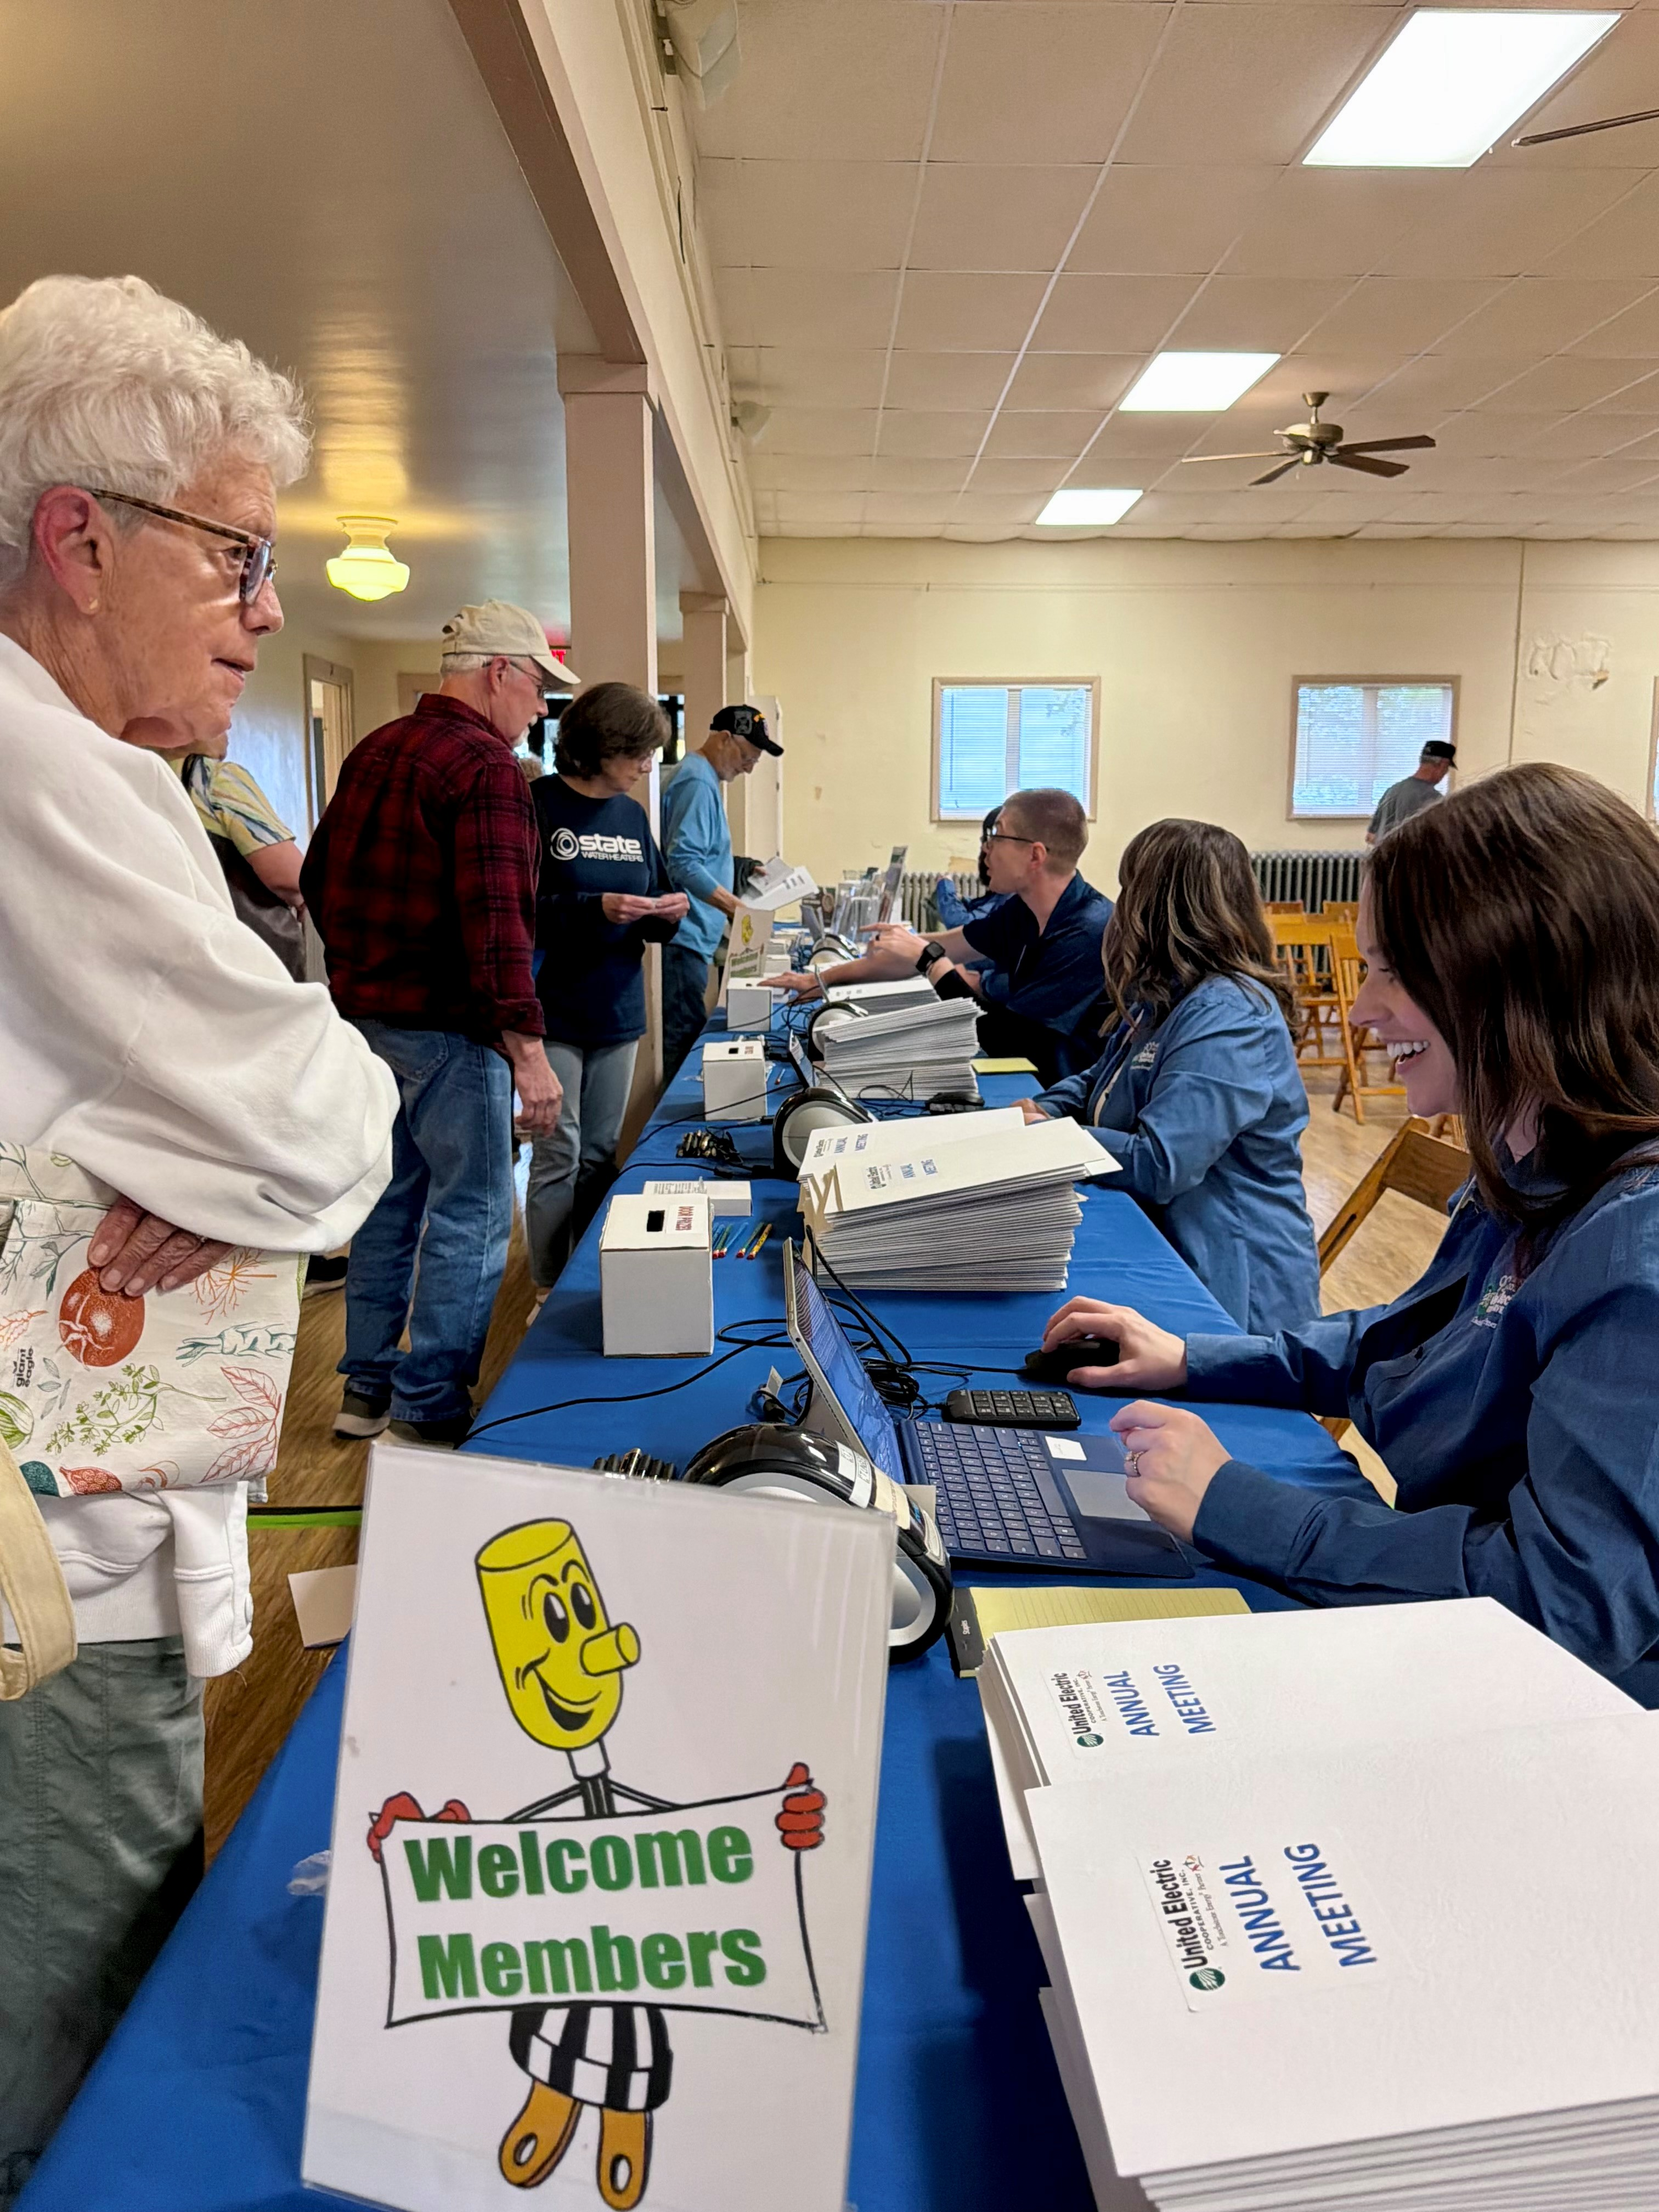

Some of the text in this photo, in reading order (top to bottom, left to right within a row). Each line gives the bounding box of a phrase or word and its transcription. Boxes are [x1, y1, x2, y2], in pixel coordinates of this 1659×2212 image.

[579, 833, 642, 855] state
[581, 851, 644, 862] WATER HEATERS
[16, 1349, 26, 1387] giant
[25, 1347, 35, 1387] eagle
[1051, 1672, 1092, 1735] United Electric
[1103, 1671, 1160, 1736] ANNUAL
[1153, 1664, 1217, 1734] MEETING
[403, 1825, 754, 1903] Welcome
[1149, 1859, 1208, 1969] United Electric
[1179, 1869, 1214, 1951] COOPERATIVE, INC.
[1219, 1855, 1301, 1971] ANNUAL
[1284, 1843, 1377, 1967] MEETING
[417, 1925, 767, 1999] Members
